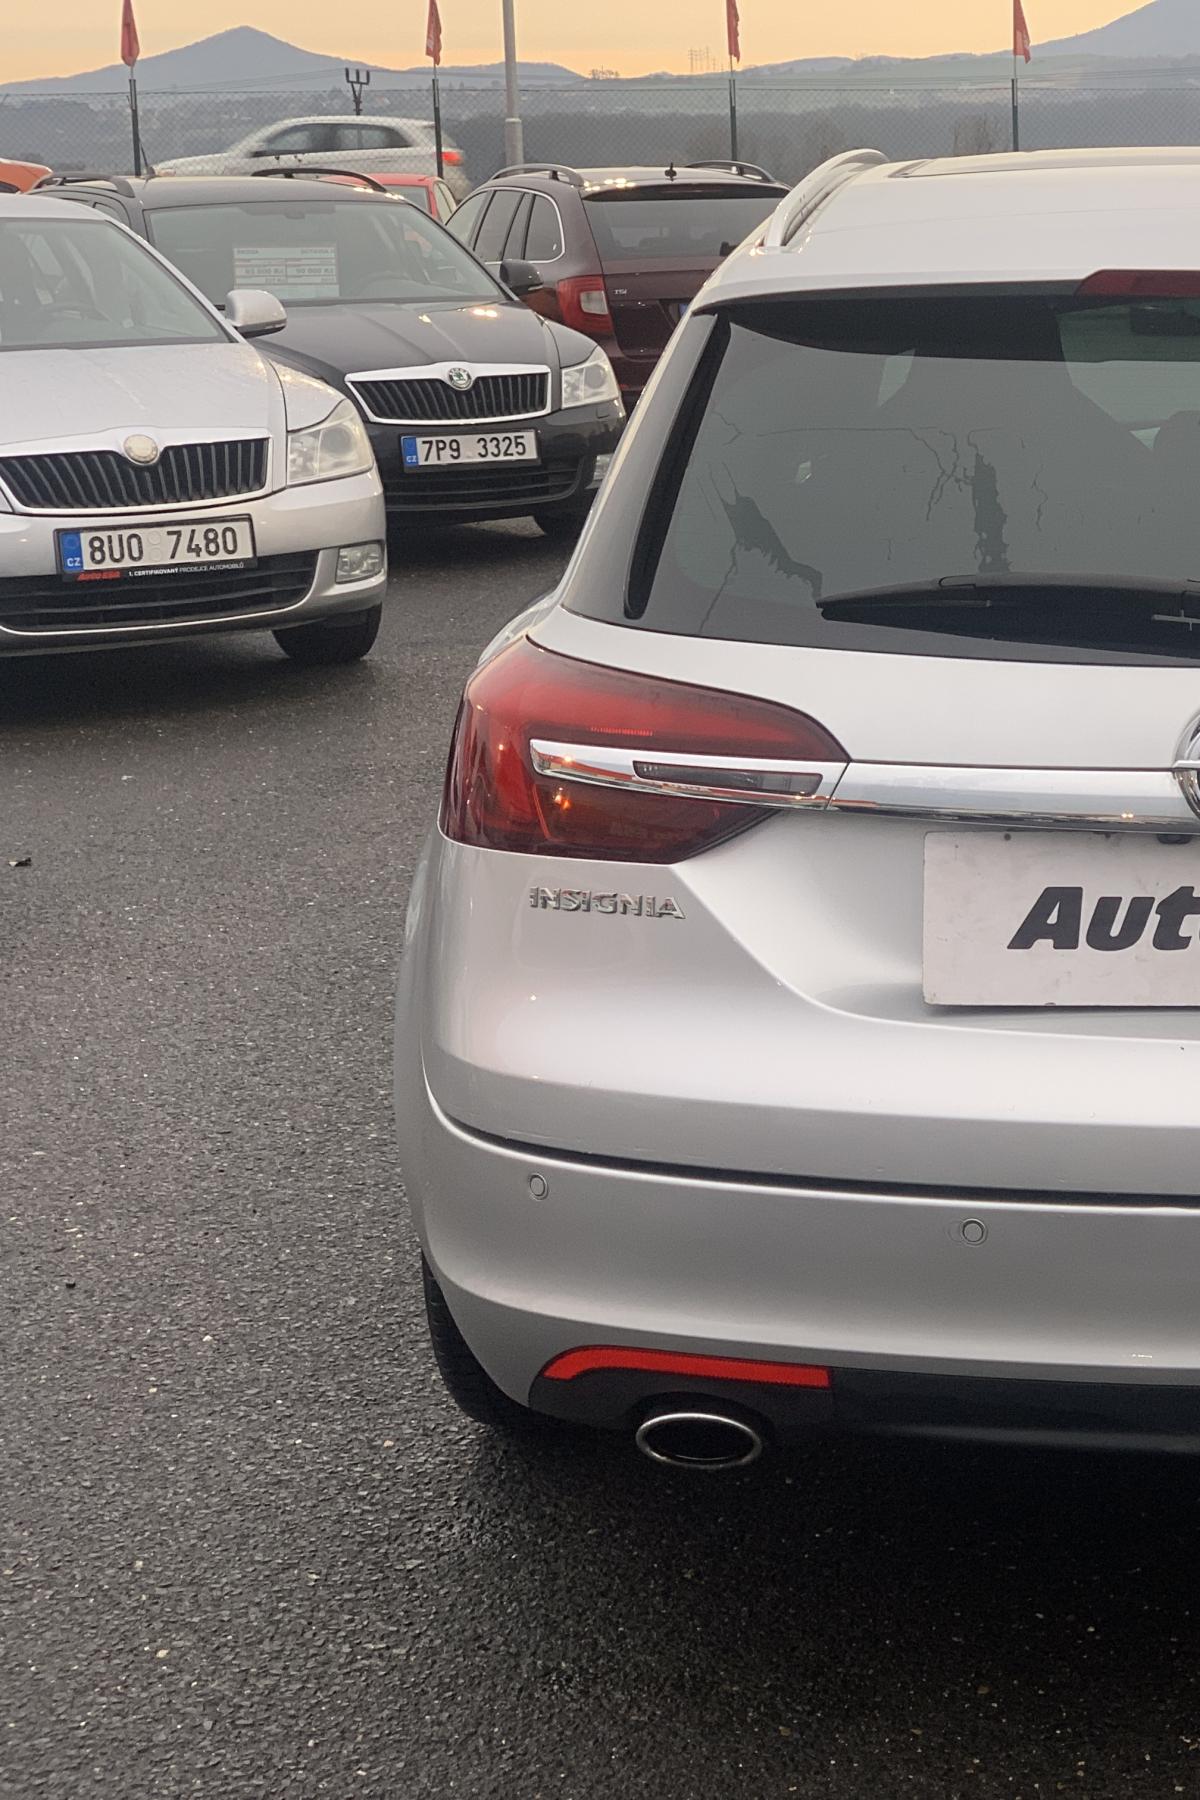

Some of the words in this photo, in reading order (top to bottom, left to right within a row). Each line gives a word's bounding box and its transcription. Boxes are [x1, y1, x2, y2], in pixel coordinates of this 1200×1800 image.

[406, 455, 417, 463] CZ
[422, 439, 461, 462] 7P9
[476, 435, 526, 458] 3325
[66, 557, 81, 567] CZ
[166, 526, 238, 560] 7480
[529, 886, 686, 919] INSIGNIA
